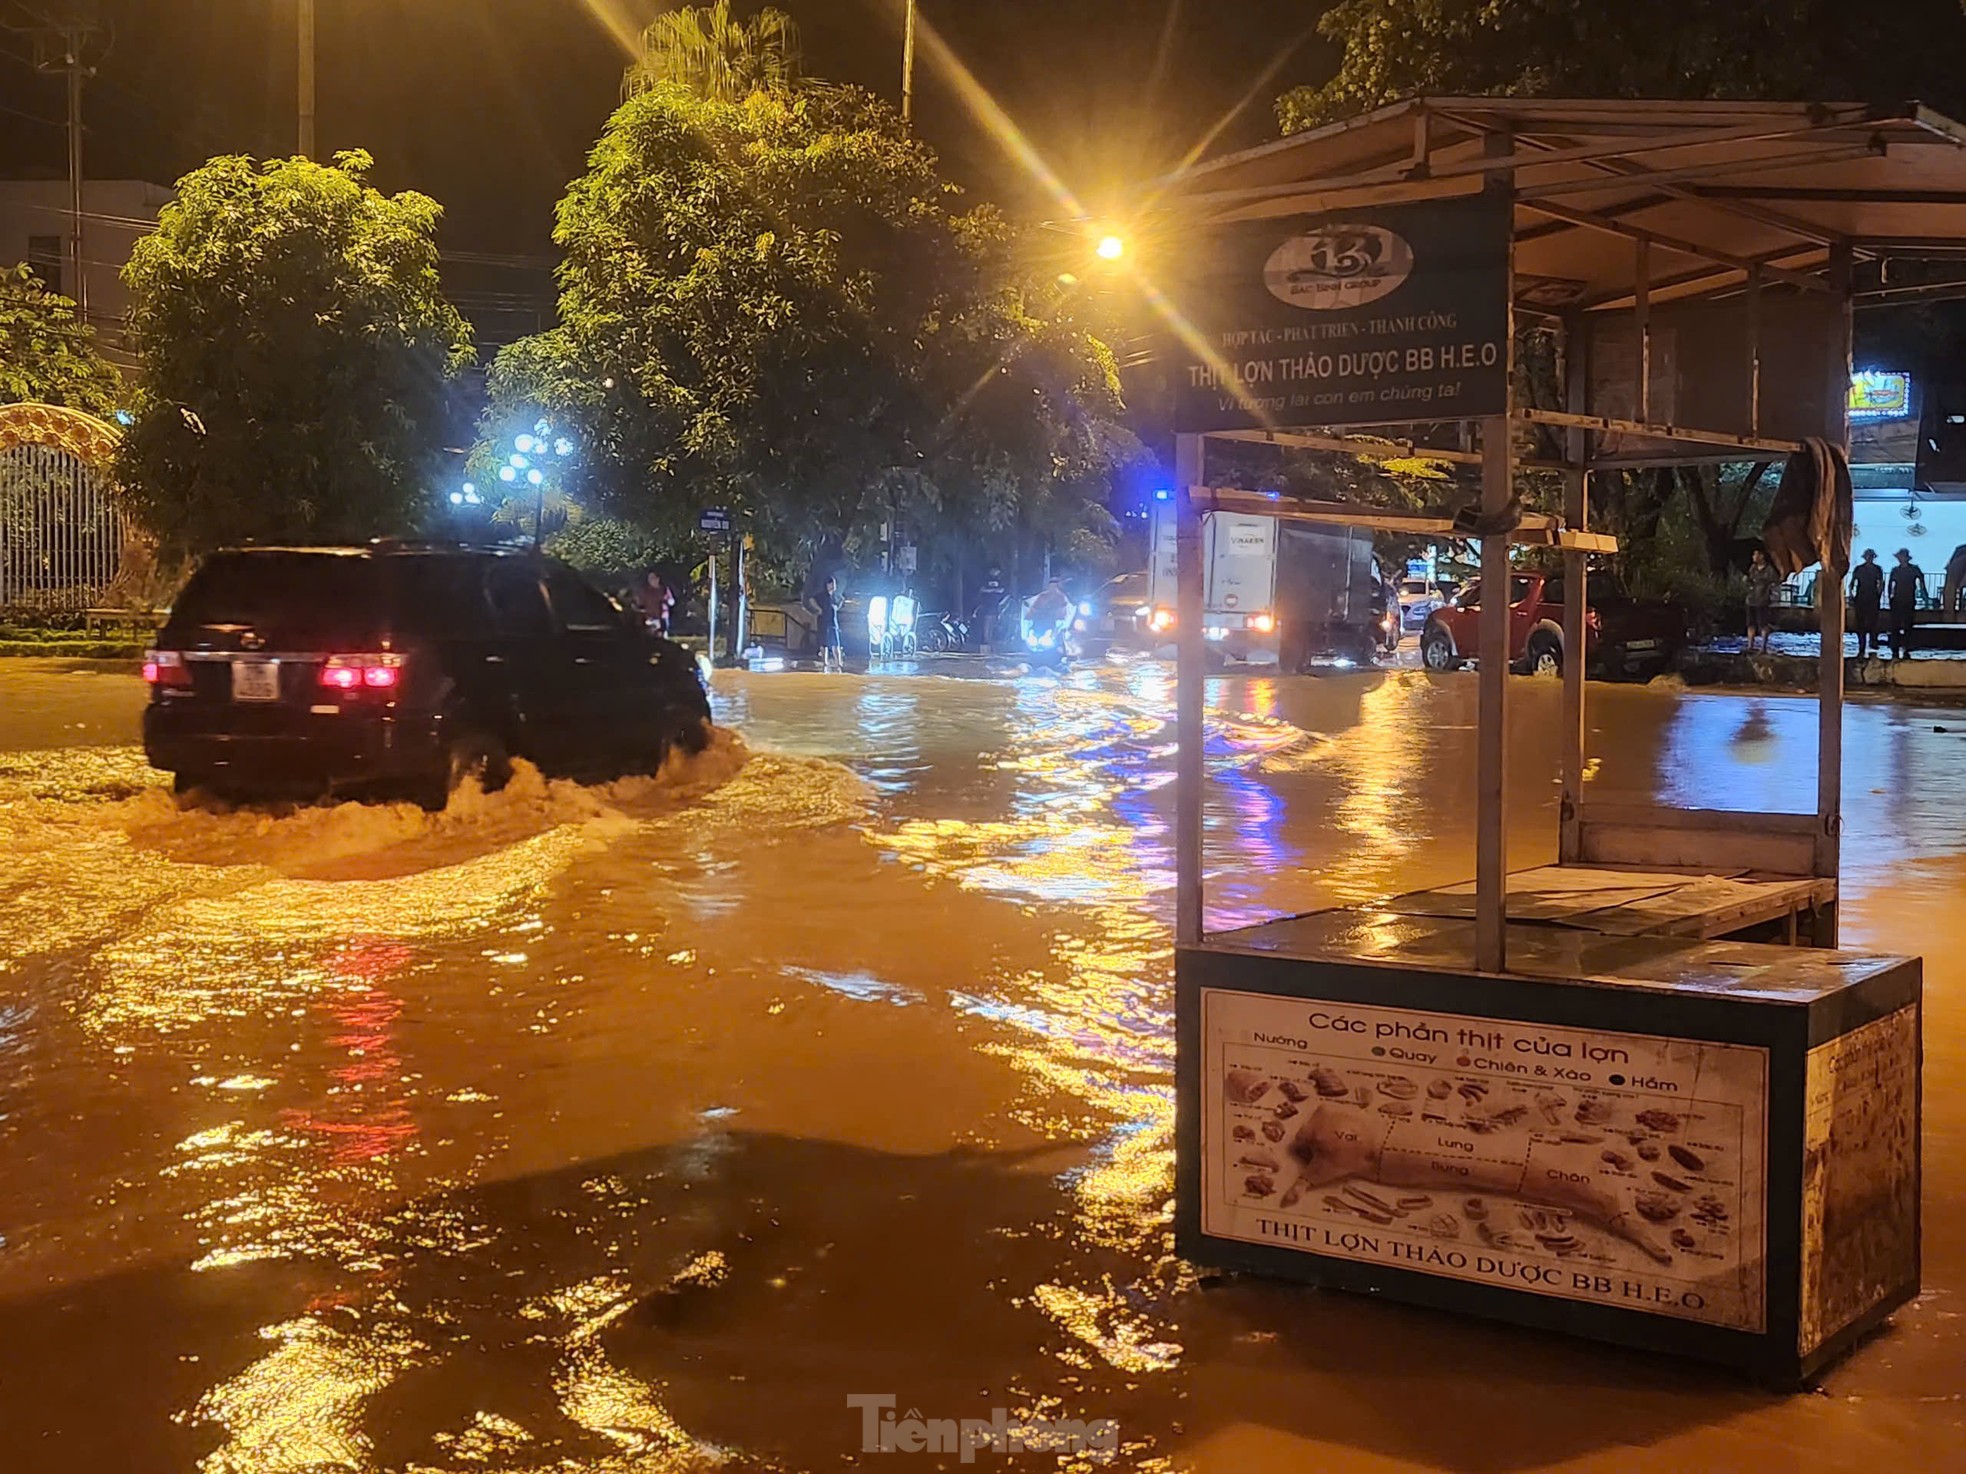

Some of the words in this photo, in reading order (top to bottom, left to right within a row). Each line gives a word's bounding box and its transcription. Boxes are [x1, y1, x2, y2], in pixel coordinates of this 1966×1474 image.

[1188, 362, 1229, 391] THỊT
[1234, 360, 1273, 388] LỢN
[1279, 351, 1333, 381] THẢO
[1338, 350, 1399, 380] DƯỢC
[1406, 348, 1434, 371] BB
[1440, 342, 1497, 369] H.E.O
[1313, 392, 1344, 405] con
[1350, 390, 1375, 403] em
[1438, 382, 1461, 398] ta!
[1309, 1012, 1367, 1034] Các
[1456, 1028, 1504, 1051] thịt
[1514, 1036, 1572, 1059] của
[1582, 1041, 1629, 1065] lợn
[1389, 1047, 1437, 1065] Quay
[1474, 1056, 1528, 1075] Chiên
[1534, 1064, 1548, 1077] &
[1256, 1218, 1317, 1242] THỊT
[1325, 1230, 1380, 1253] LỢN
[1387, 1240, 1467, 1268] THẢO
[1477, 1255, 1562, 1285] DƯỢC
[1572, 1272, 1613, 1293] BB
[1623, 1280, 1705, 1310] H.E.O
